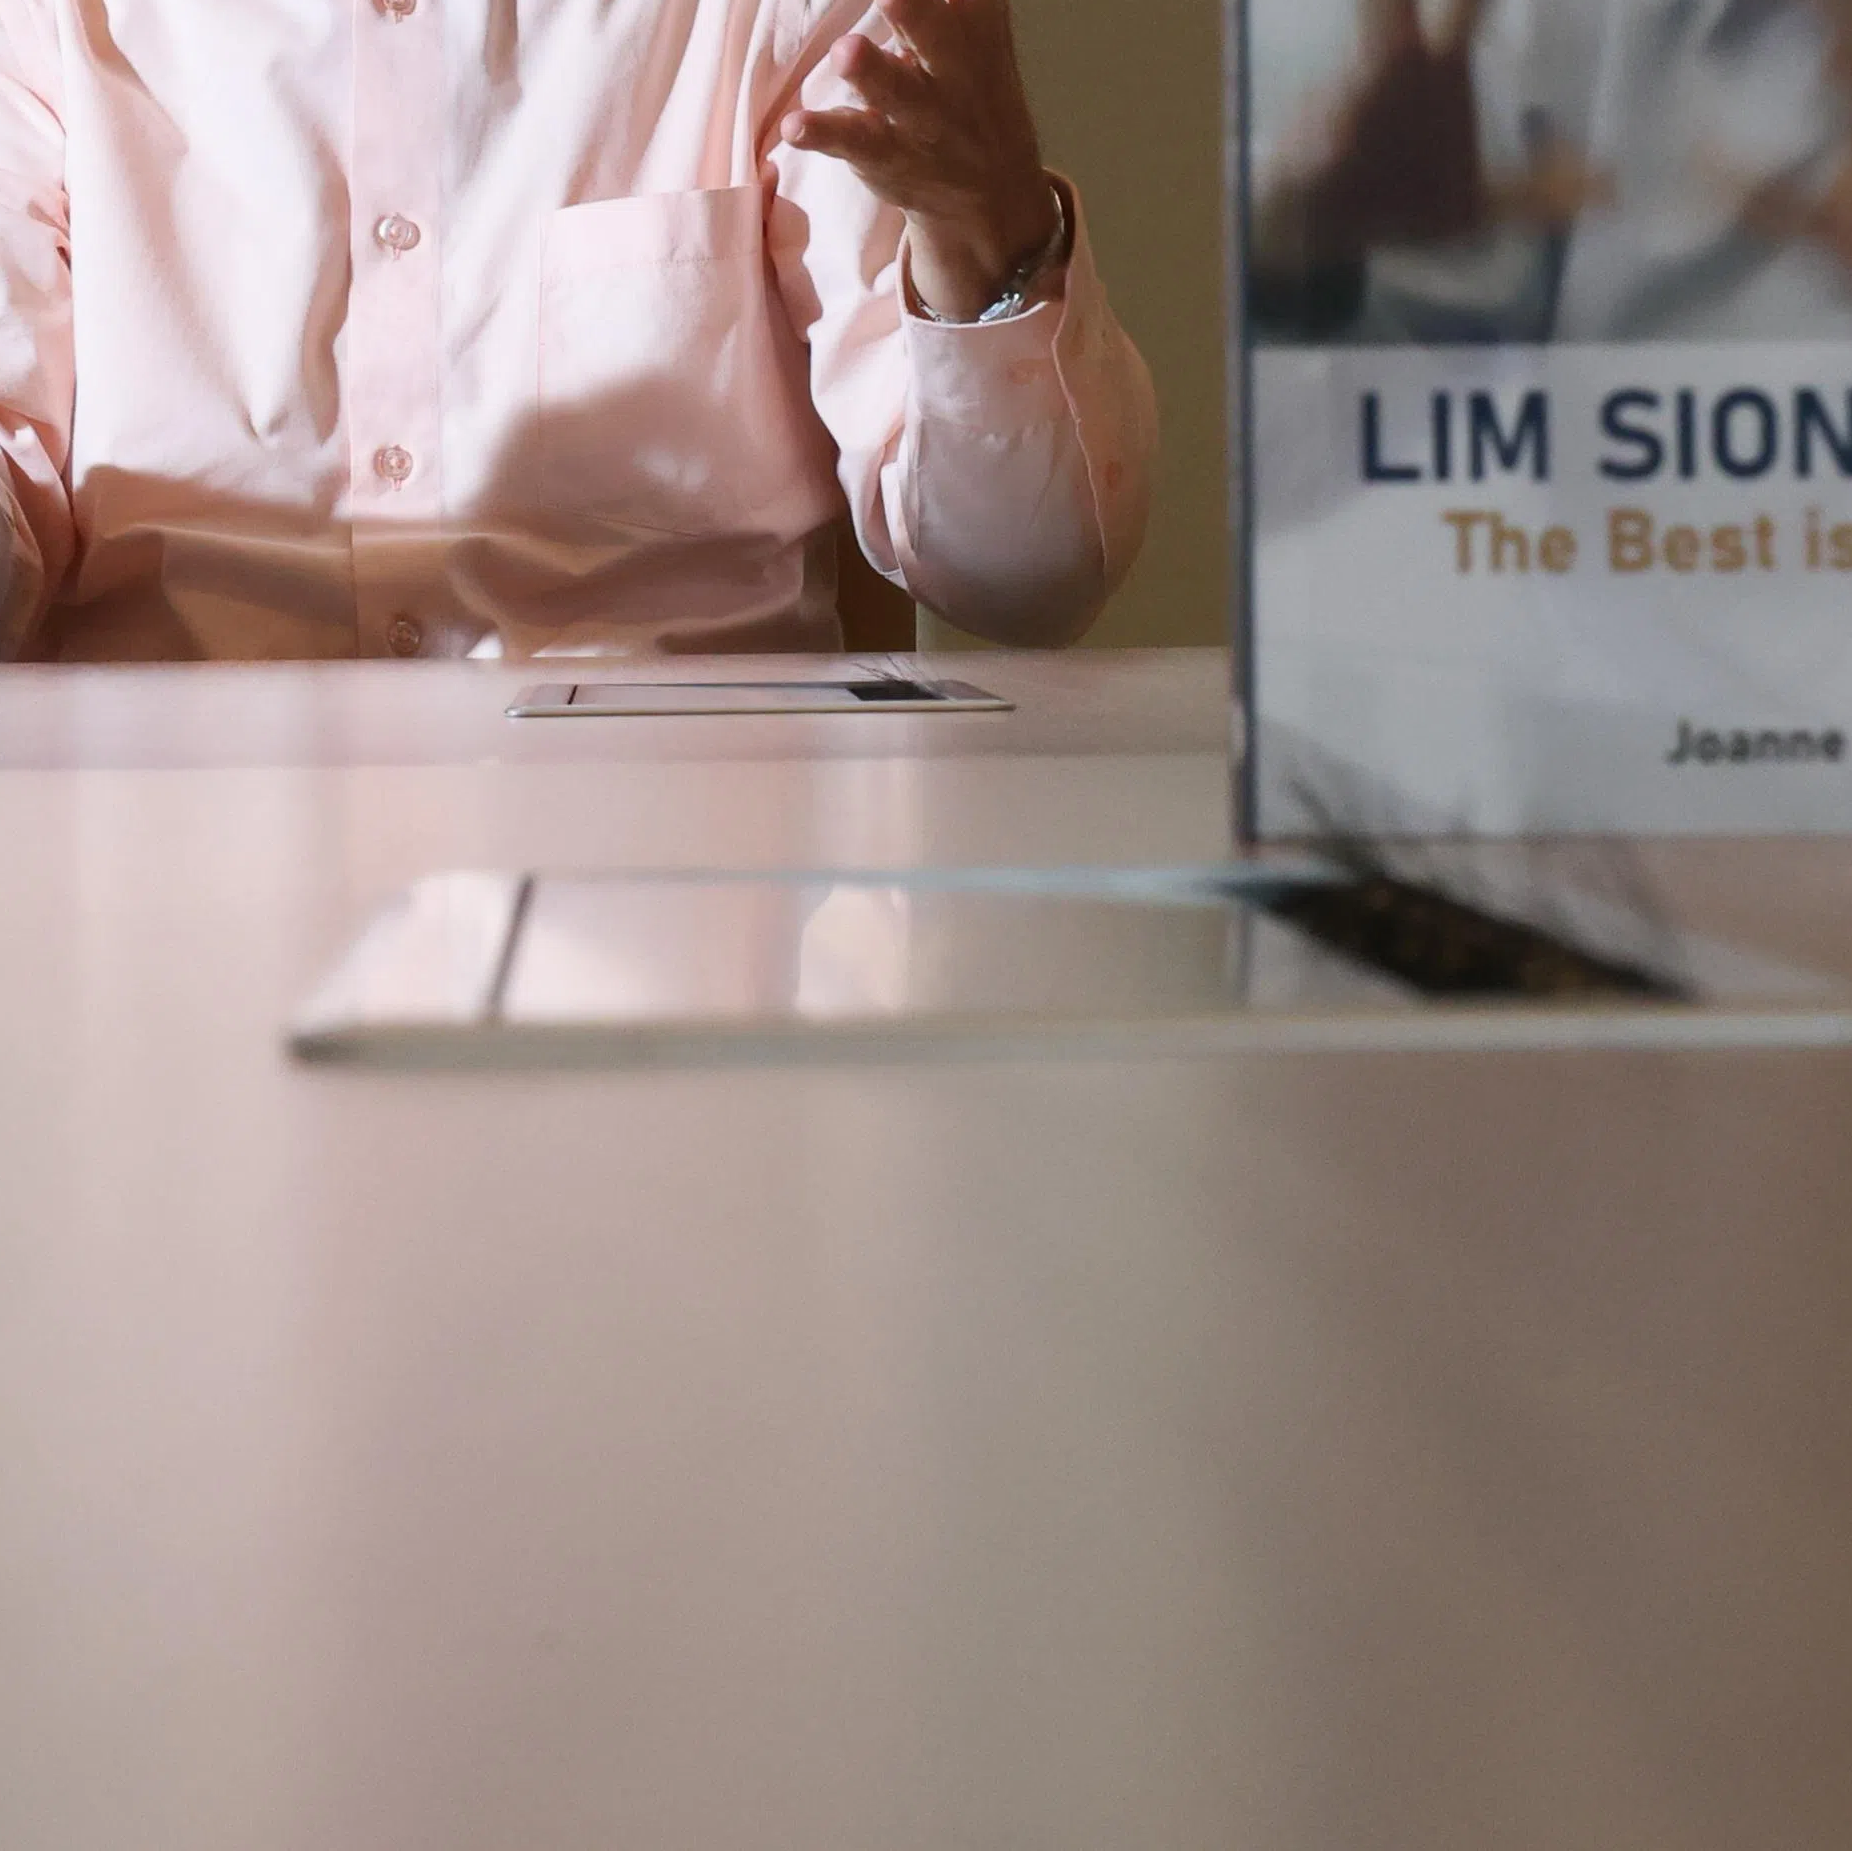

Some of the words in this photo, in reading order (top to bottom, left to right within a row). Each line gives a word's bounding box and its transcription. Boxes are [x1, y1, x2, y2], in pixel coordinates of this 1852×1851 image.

[1361, 391, 1548, 482] LIM
[1440, 511, 1576, 573] The
[1609, 509, 1775, 571] Best
[1665, 722, 1844, 764] Joanne
